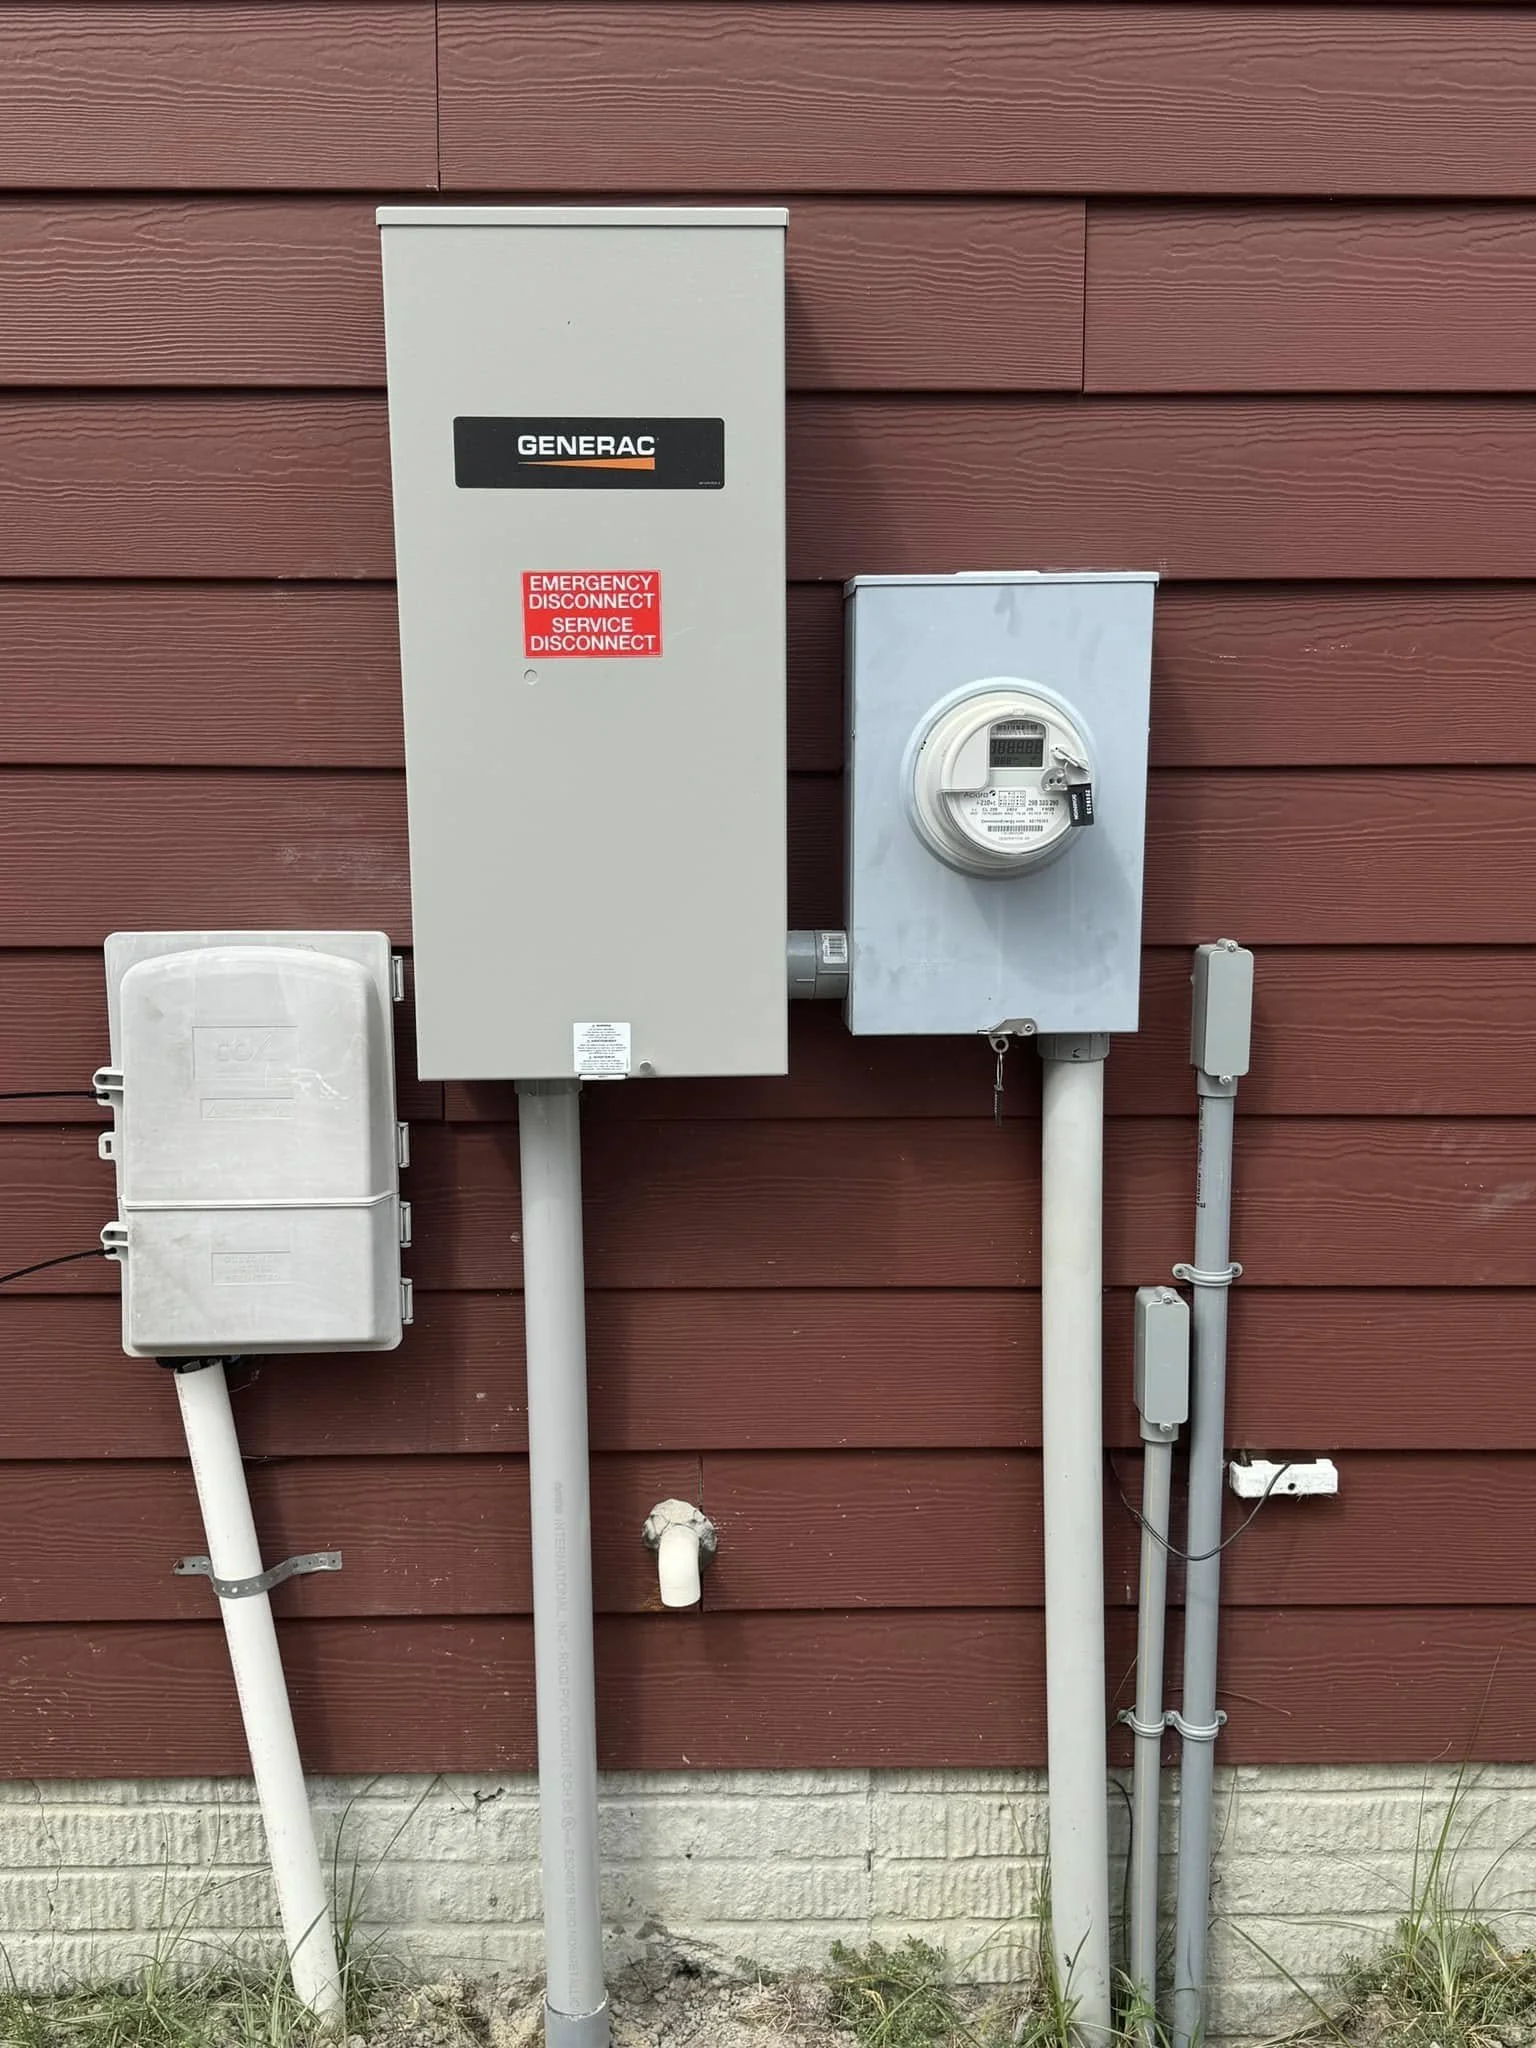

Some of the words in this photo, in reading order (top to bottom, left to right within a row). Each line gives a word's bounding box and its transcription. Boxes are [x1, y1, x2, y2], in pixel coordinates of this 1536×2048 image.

[517, 435, 656, 456] GENERAC
[530, 575, 653, 591] EMERGENCY
[529, 593, 656, 610] DISCONNECT
[552, 617, 633, 633] SERVICE
[530, 635, 656, 651] DISCONNECT
[557, 1651, 570, 1685] RIGID
[559, 1688, 571, 1712] PVC
[560, 1715, 573, 1768] CONDUIT
